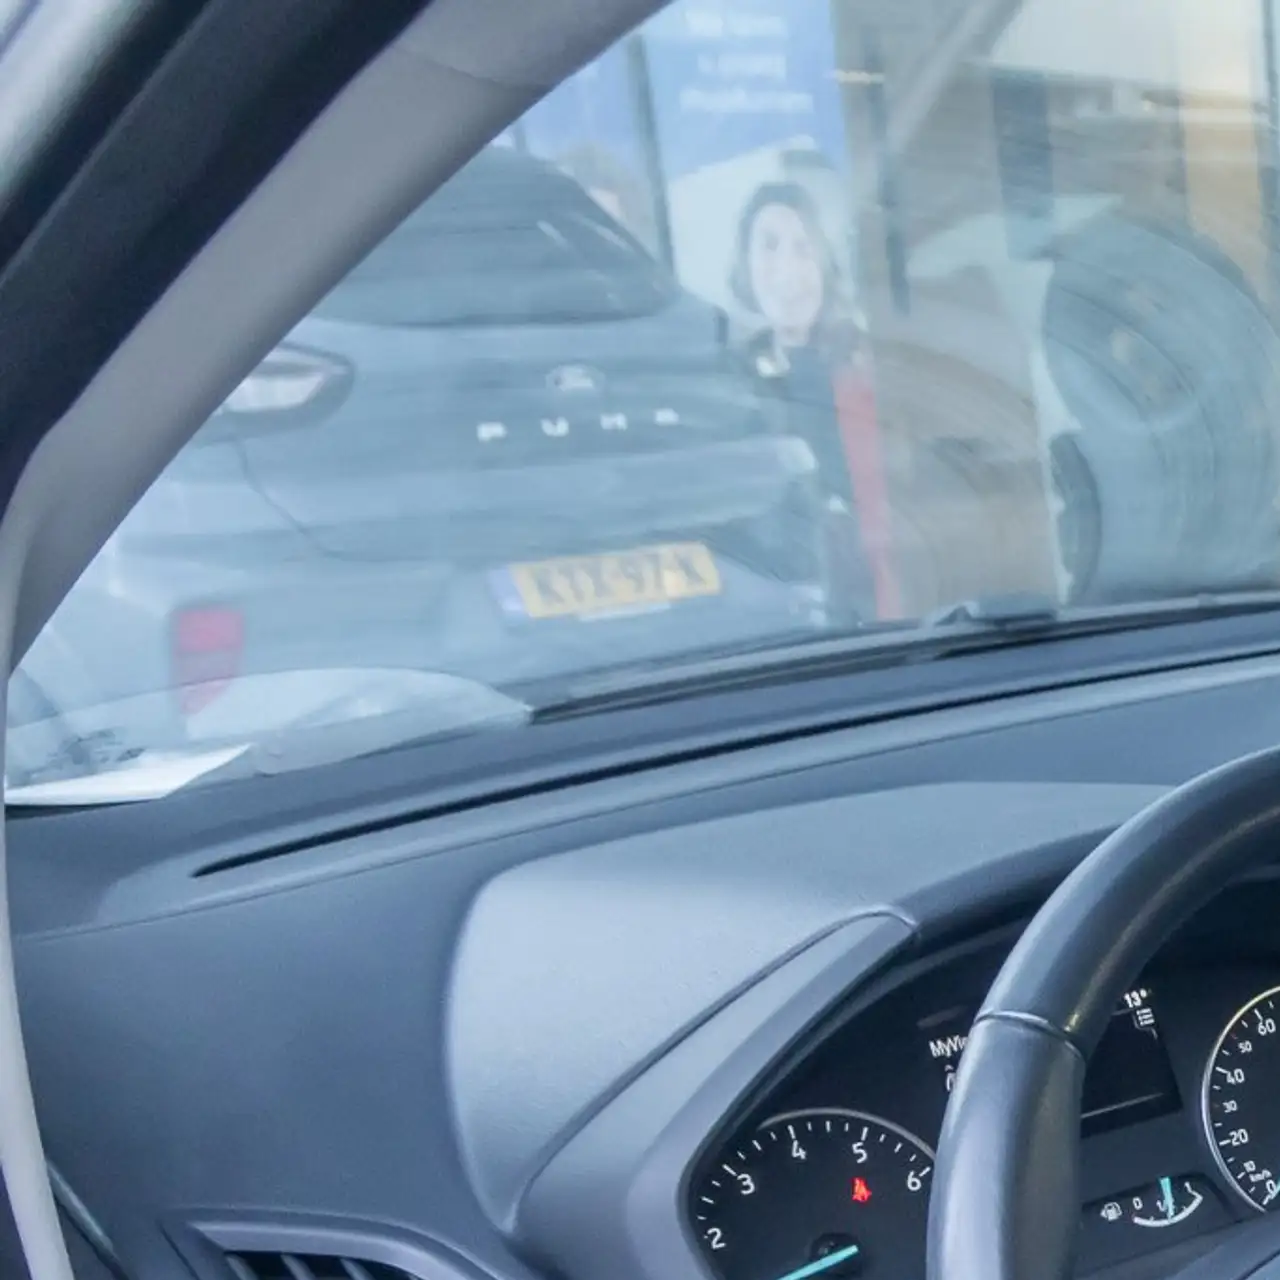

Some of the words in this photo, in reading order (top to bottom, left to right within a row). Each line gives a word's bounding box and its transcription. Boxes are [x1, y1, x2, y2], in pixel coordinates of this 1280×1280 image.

[1257, 1018, 1277, 1037] 60
[1237, 1040, 1253, 1054] 50
[1225, 1067, 1245, 1085] 40
[1222, 1100, 1238, 1113] 30
[1229, 1128, 1249, 1146] 20
[791, 1140, 807, 1160] 4
[851, 1141, 868, 1164] 5
[736, 1173, 756, 1196] 3
[906, 1170, 922, 1192] 6
[706, 1226, 727, 1250] 2
